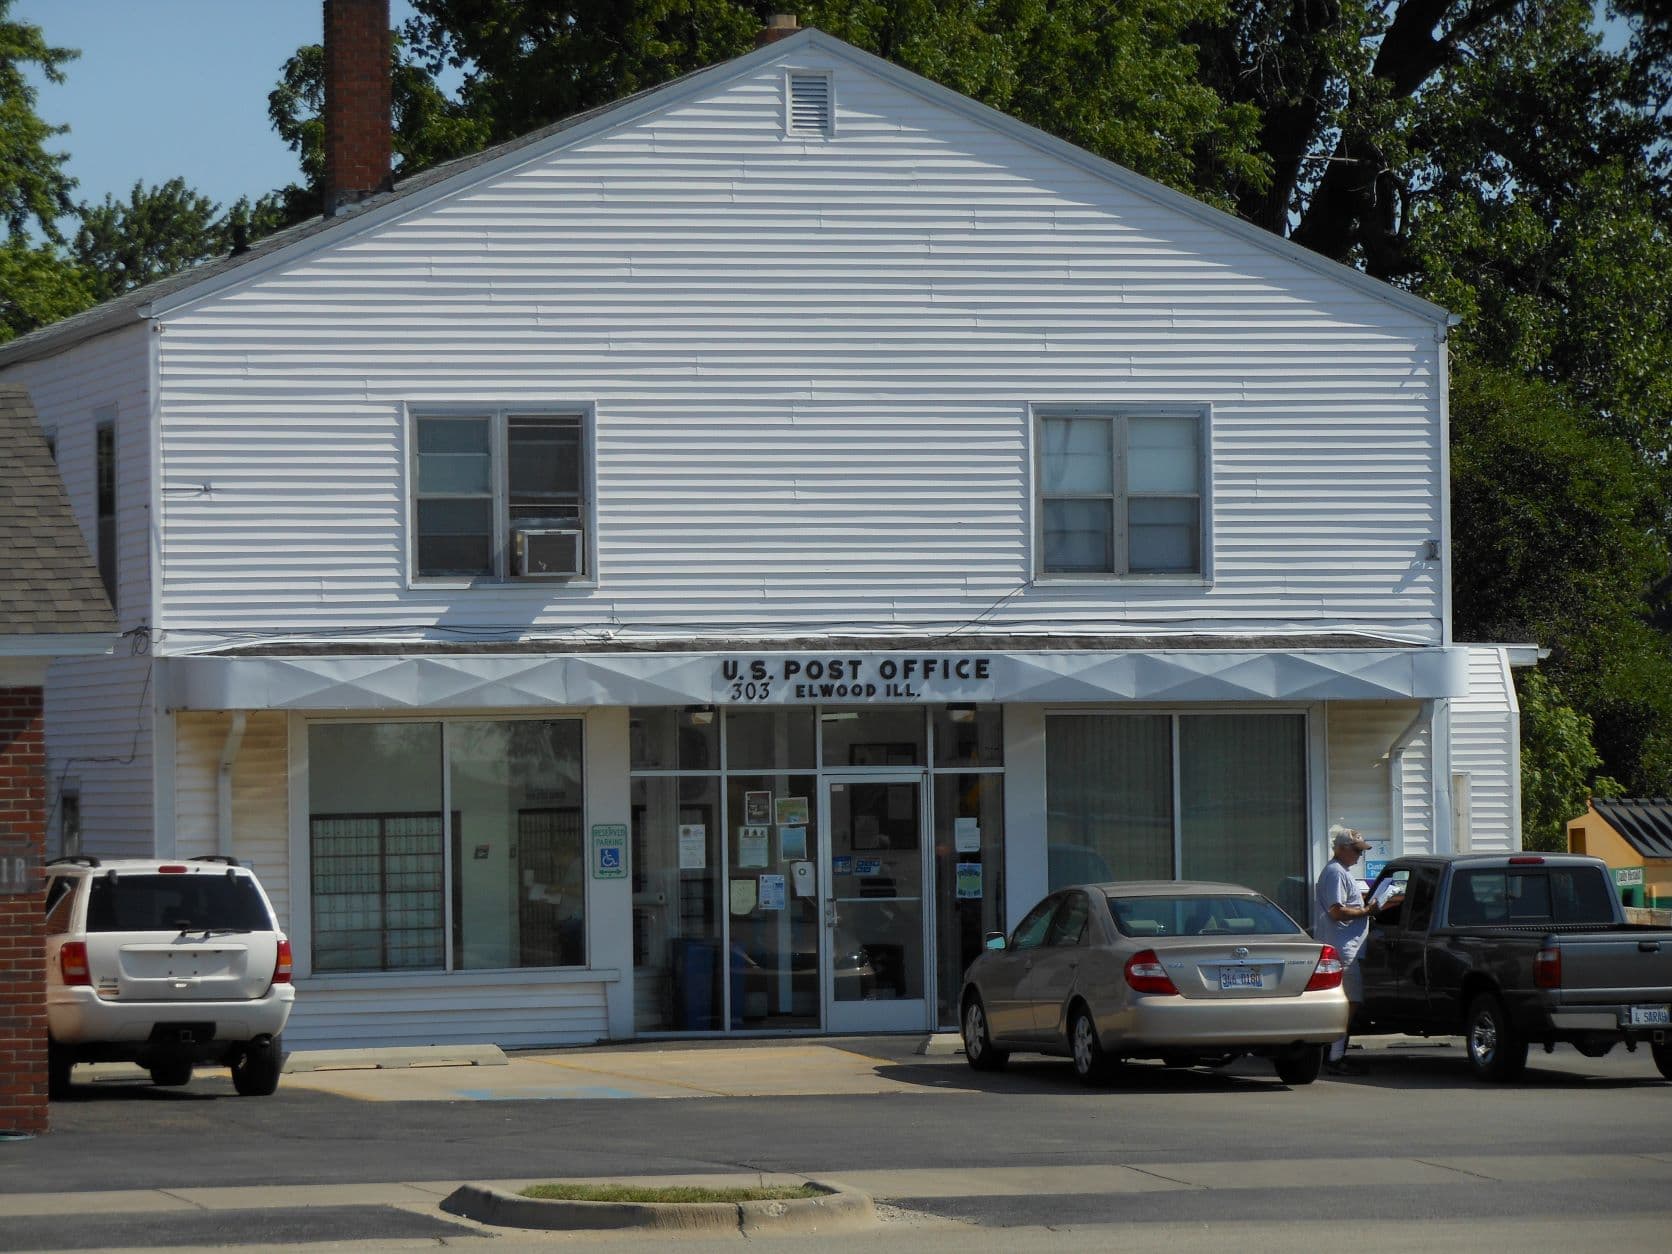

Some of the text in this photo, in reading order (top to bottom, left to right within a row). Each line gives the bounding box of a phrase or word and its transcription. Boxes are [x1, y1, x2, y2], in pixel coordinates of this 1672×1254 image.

[722, 658, 990, 681] U.S. POST OFFICE
[731, 682, 770, 700] 303
[796, 683, 921, 698] ELWOOD ILL.
[593, 829, 625, 837] RESERVED
[595, 838, 624, 846] PARKING
